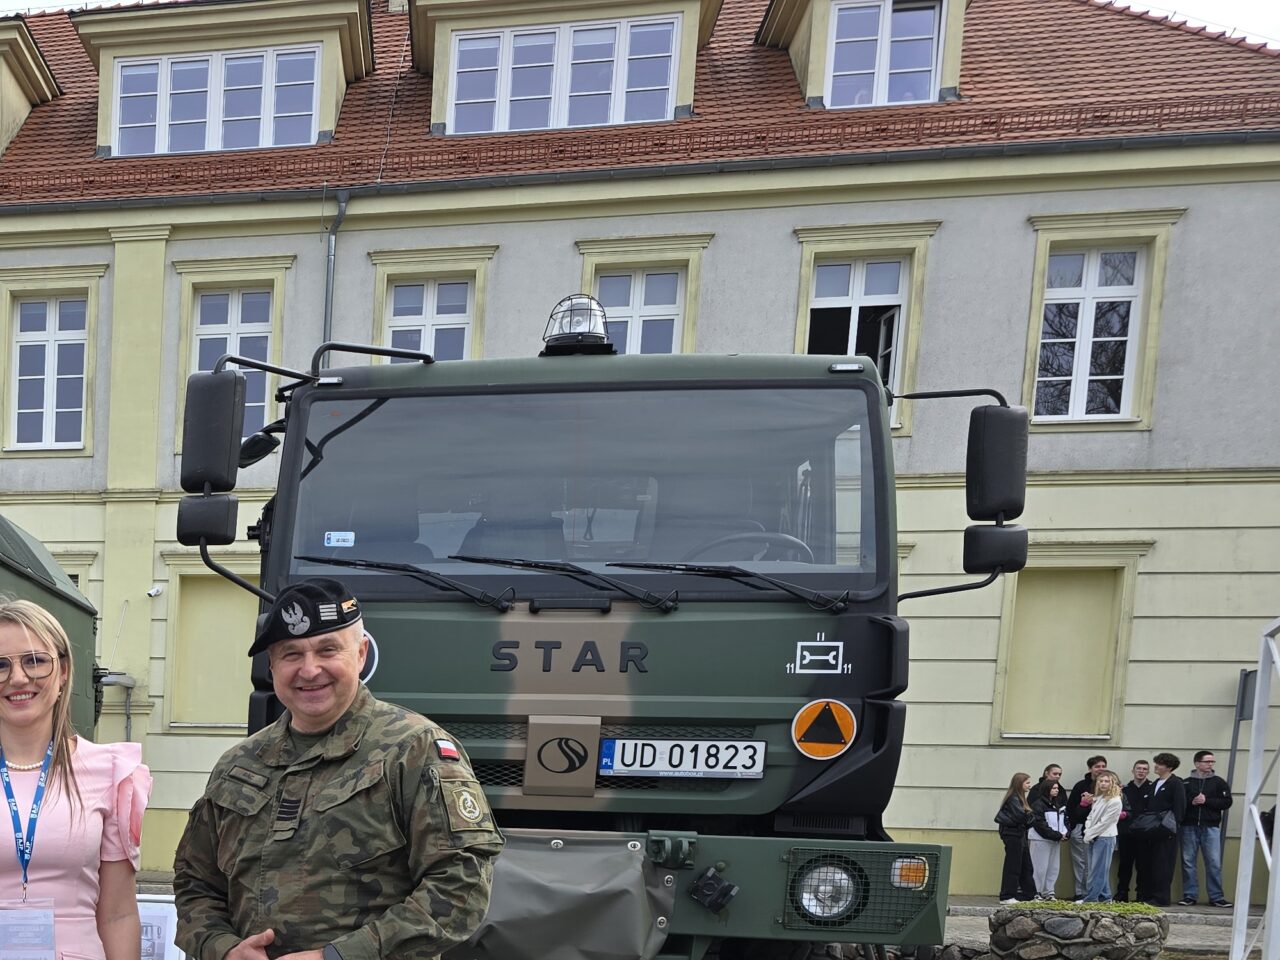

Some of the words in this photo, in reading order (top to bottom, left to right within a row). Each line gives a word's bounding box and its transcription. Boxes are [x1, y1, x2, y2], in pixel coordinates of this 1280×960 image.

[490, 640, 649, 673] STAR
[602, 758, 613, 766] PL
[620, 742, 657, 768] UD
[668, 743, 758, 770] 01823
